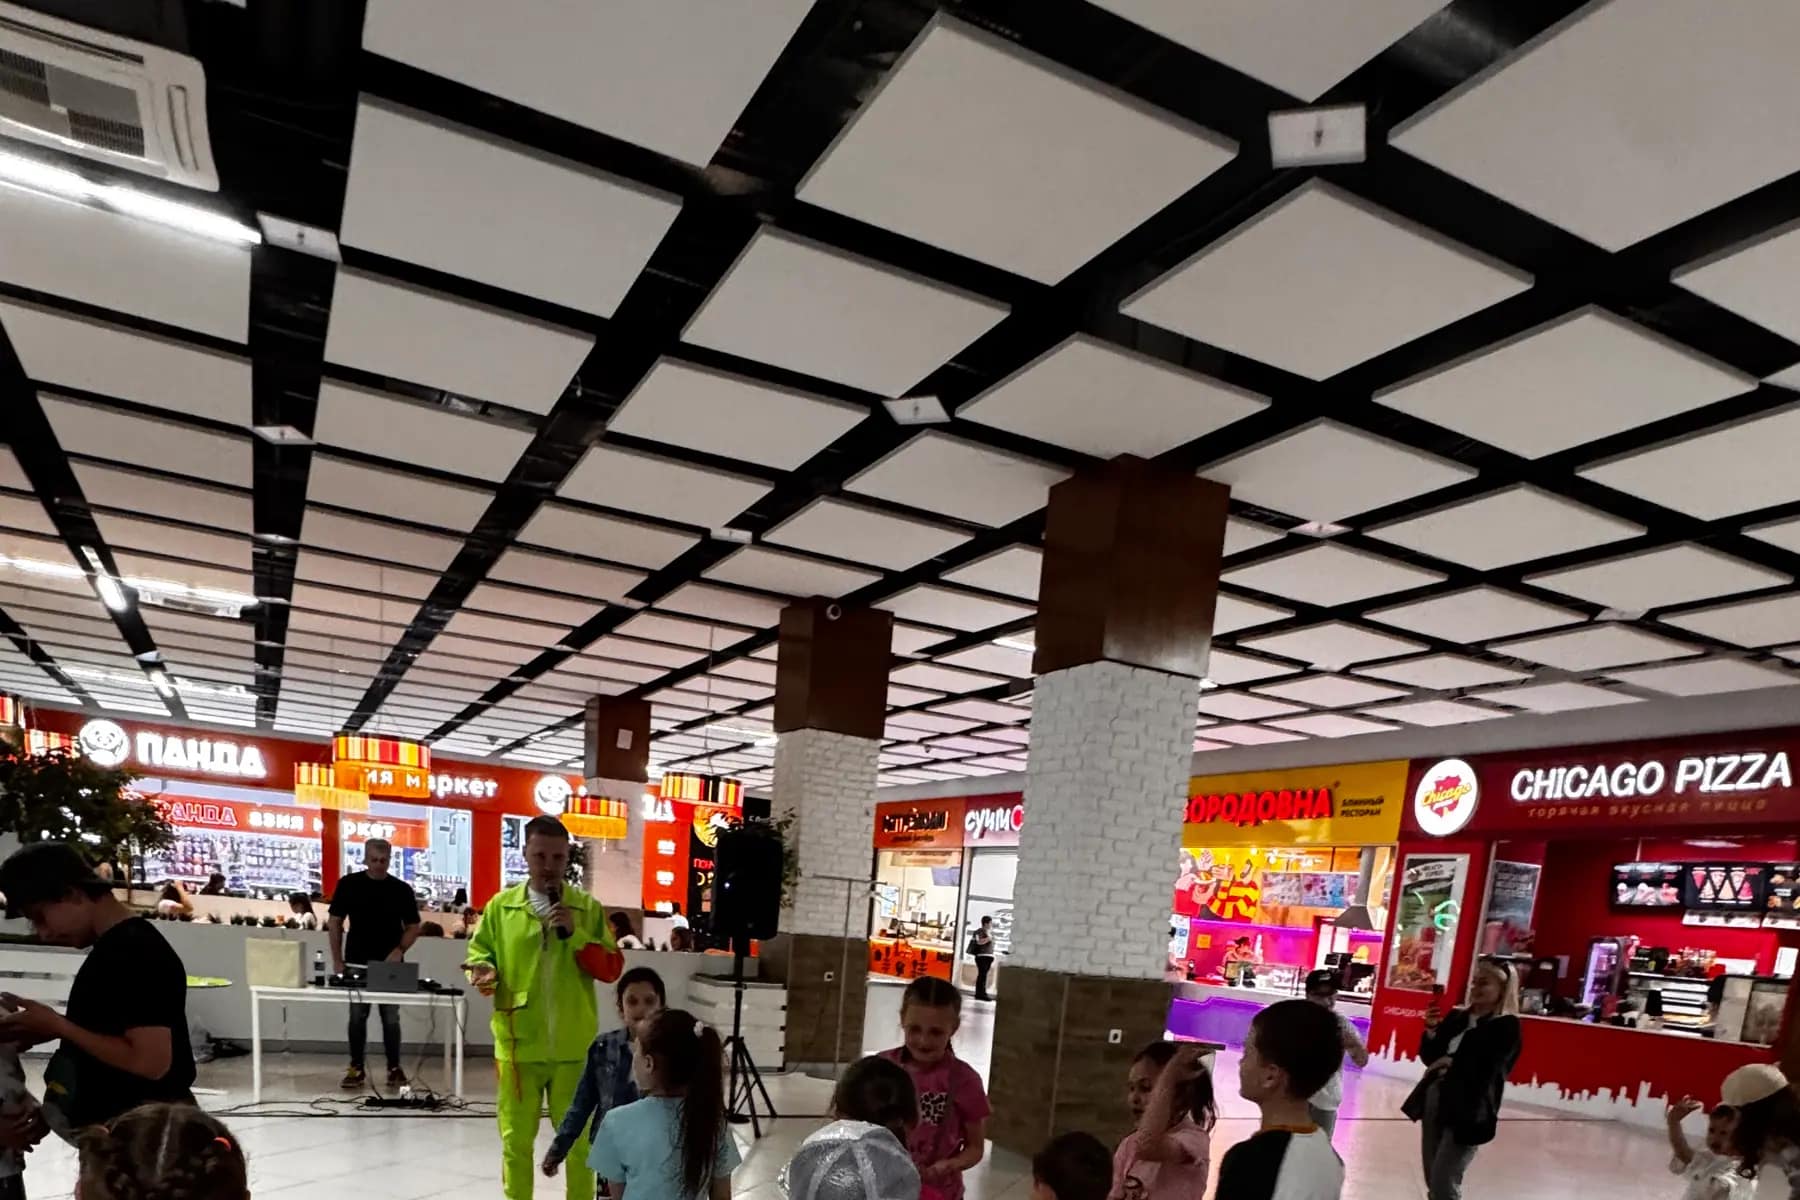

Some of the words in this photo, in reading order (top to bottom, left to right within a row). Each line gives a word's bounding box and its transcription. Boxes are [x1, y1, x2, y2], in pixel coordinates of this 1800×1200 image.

[136, 731, 267, 778] ПАНДА
[1511, 762, 1665, 801] CHICAGO
[1674, 751, 1792, 794] PIZZA
[1183, 788, 1332, 827] ОРОДОВНА
